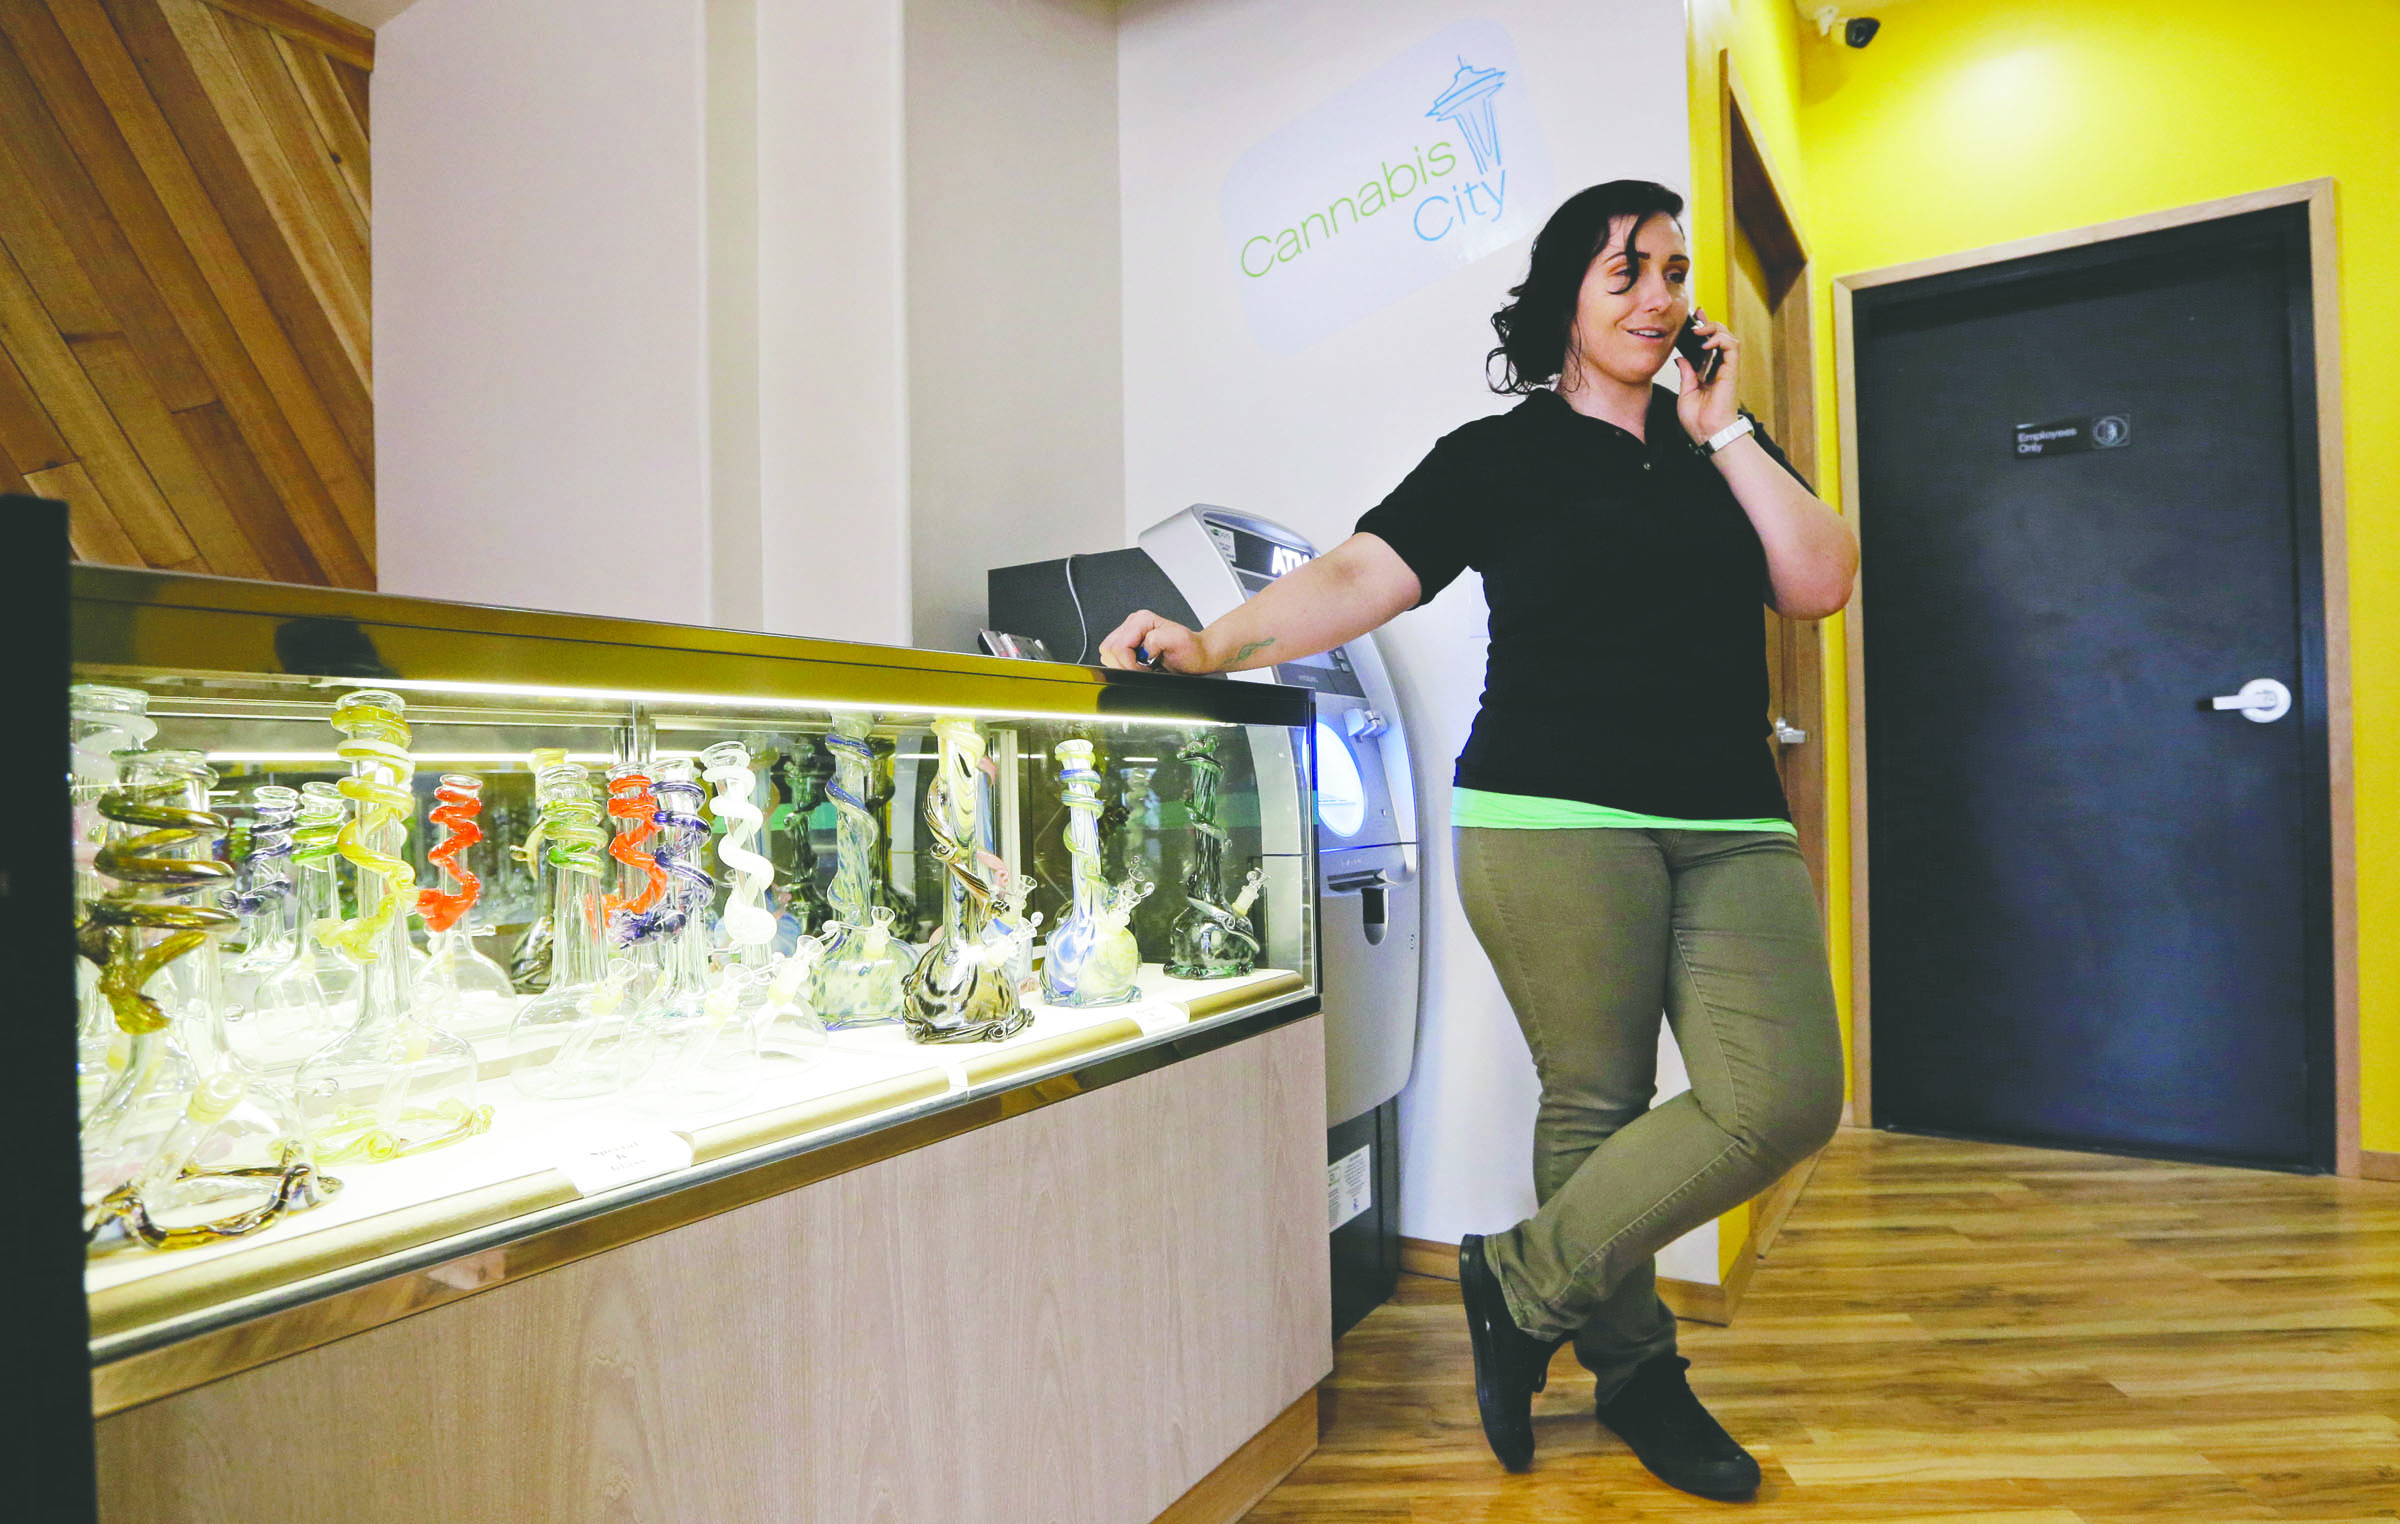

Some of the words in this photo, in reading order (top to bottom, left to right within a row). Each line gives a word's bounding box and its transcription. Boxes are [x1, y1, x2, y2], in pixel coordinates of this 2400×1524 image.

[1241, 141, 1457, 278] Cannabis
[1413, 169, 1505, 242] City
[2017, 443, 2043, 453] Only
[2018, 428, 2077, 442] Employees
